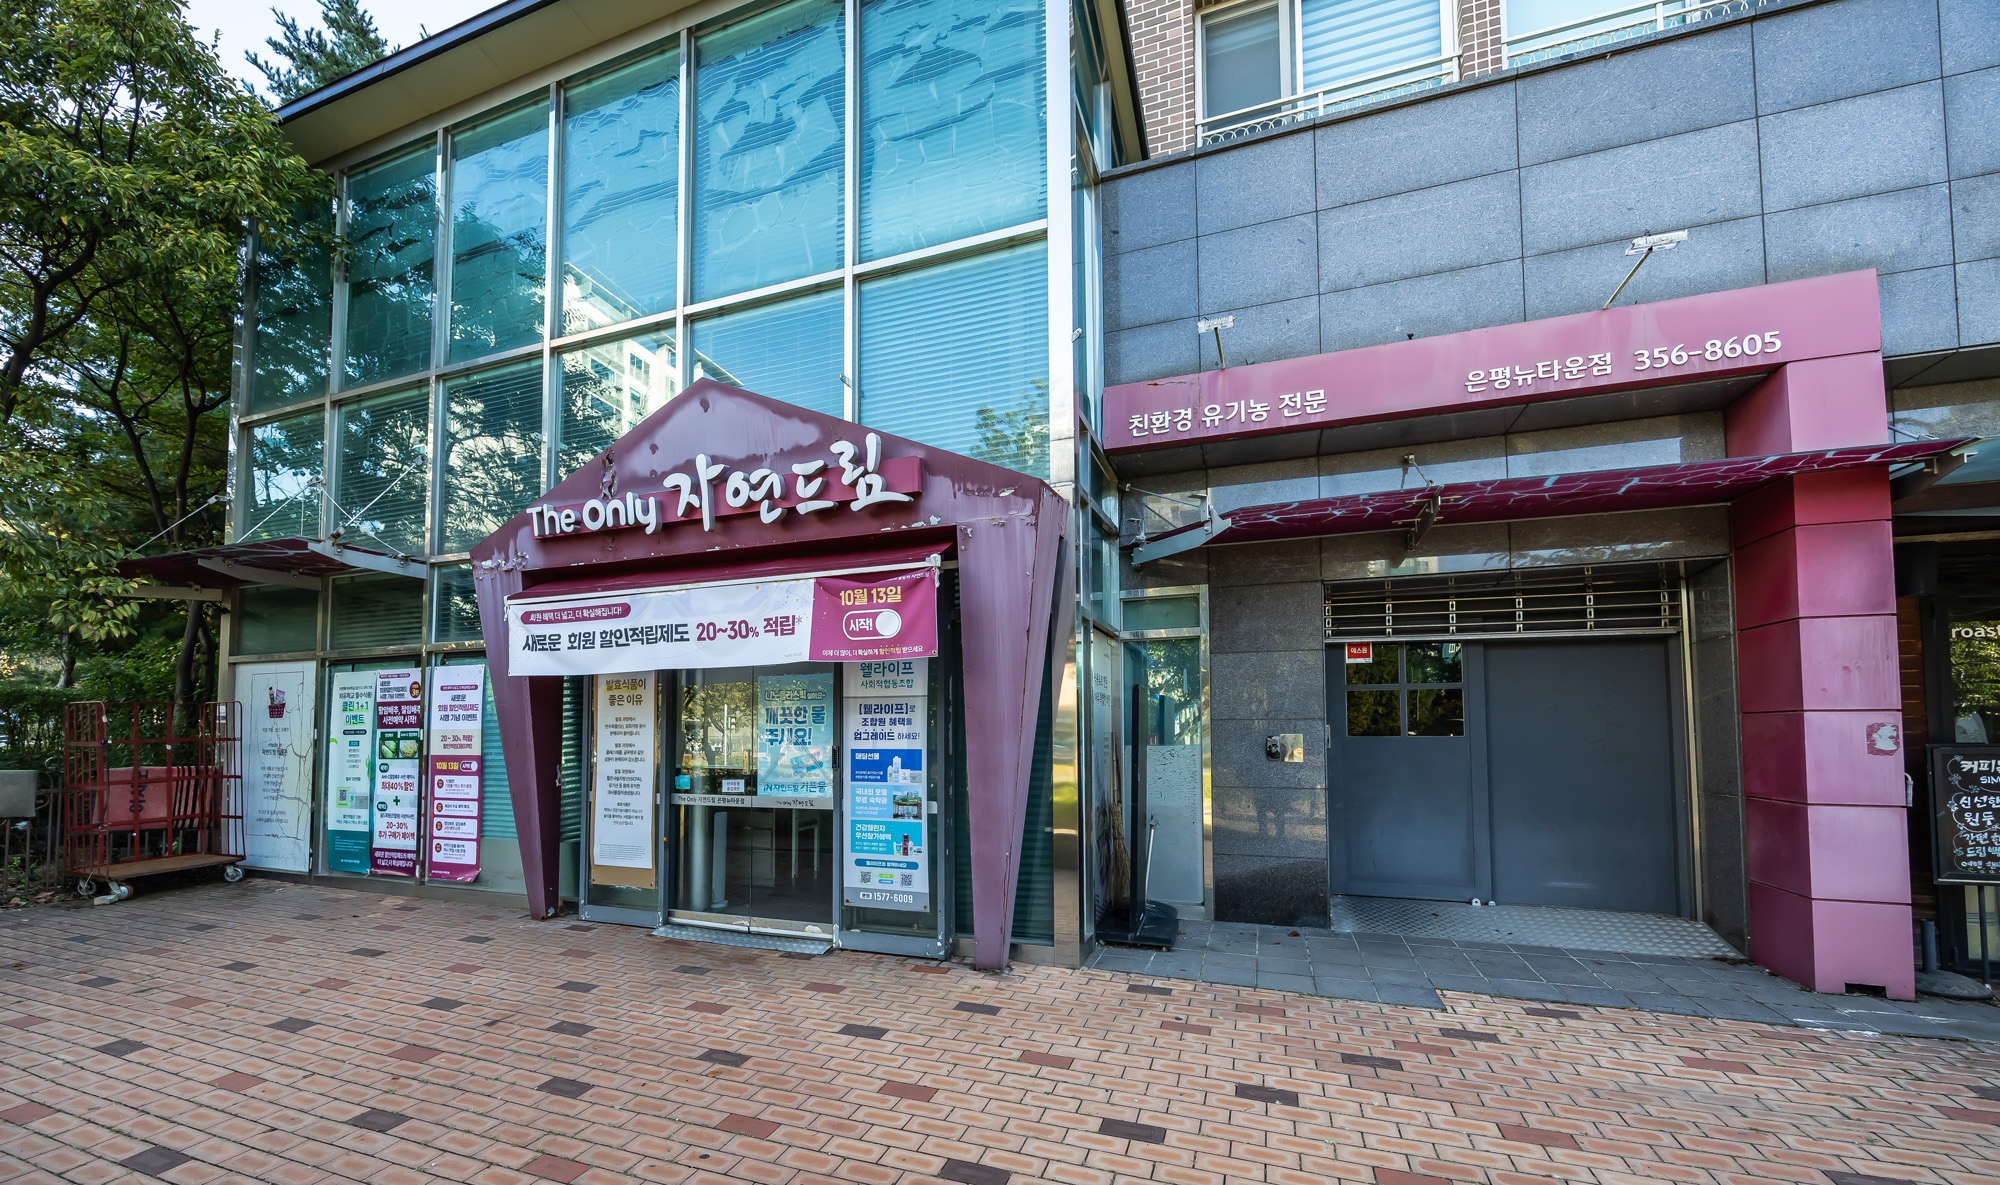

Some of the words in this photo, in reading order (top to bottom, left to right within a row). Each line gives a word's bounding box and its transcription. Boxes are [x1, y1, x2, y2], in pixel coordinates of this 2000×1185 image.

[1464, 352, 1613, 393] 은평뉴타운점
[1633, 331, 1783, 372] 356-8605
[1128, 407, 1192, 438] 친환경
[1200, 397, 1268, 428] 유기농
[1279, 389, 1327, 419] 전문
[526, 505, 579, 537] The
[583, 491, 661, 536] Only
[663, 433, 913, 532] 자연드림
[840, 588, 868, 606] 10월
[871, 586, 902, 604] 13일
[529, 612, 542, 622] 회원
[542, 611, 554, 621] 혜택
[555, 612, 561, 620] 더
[576, 610, 582, 619] 더
[582, 606, 622, 618] 확실해집니다!
[849, 617, 873, 632] 시작!
[522, 633, 562, 652] 새로운
[567, 631, 595, 650] 회원
[600, 622, 690, 649] 할인적립제도
[696, 619, 759, 642] 20~30%
[822, 649, 833, 657] 이제
[852, 648, 858, 656] 더
[858, 647, 878, 656] 확실하게
[879, 646, 901, 655] 할인적립
[902, 645, 923, 654] 받으세요
[860, 660, 914, 678] 웰라이프
[605, 678, 646, 691] 발효식품이
[861, 679, 914, 689] 사회적협동조합
[450, 694, 466, 702] 새로운
[608, 694, 625, 706] 좋은
[626, 694, 643, 706] 이유
[342, 701, 354, 712] 클린
[356, 701, 369, 710] 1+1
[859, 703, 916, 715] [웰라이프]로
[345, 714, 365, 724] 이벤트
[382, 716, 404, 725] 사전예약
[404, 715, 417, 725] 시작!
[439, 714, 449, 722] 시행
[461, 714, 477, 722] 이벤트
[765, 706, 808, 725] 깨끗한
[811, 705, 826, 725] 물
[862, 717, 886, 727] 조합원
[889, 717, 913, 727] 혜택을
[765, 727, 813, 746] 주세요!
[854, 731, 895, 741] 업그레이드
[897, 732, 920, 740] 하세요!
[855, 752, 880, 760] 매달선물
[855, 788, 874, 796] 국내외
[875, 788, 887, 796] 호텔
[1964, 811, 1995, 826] 원두
[378, 830, 387, 839] 추가
[873, 892, 913, 904] 1577-6009
